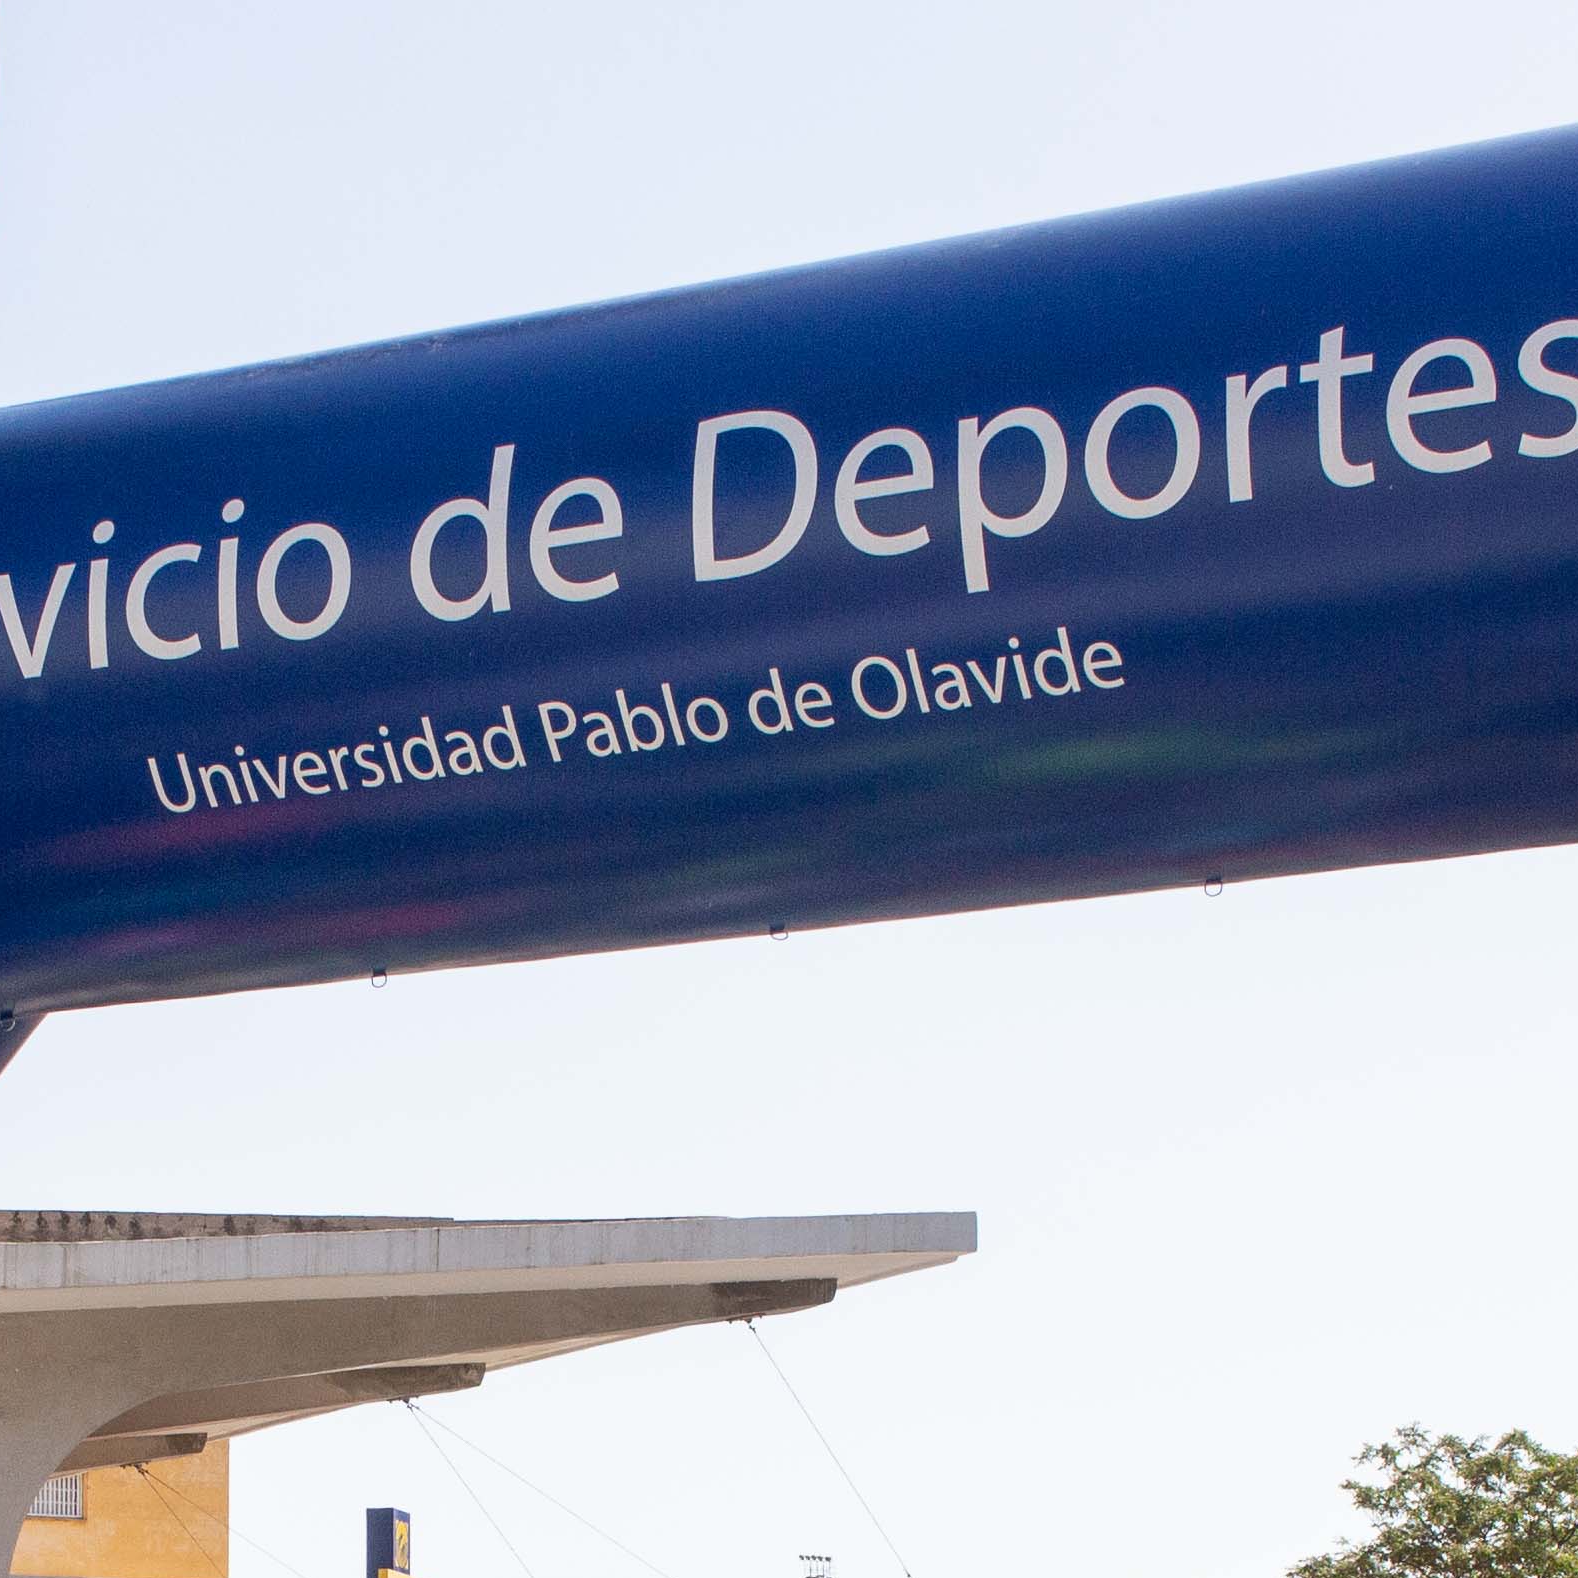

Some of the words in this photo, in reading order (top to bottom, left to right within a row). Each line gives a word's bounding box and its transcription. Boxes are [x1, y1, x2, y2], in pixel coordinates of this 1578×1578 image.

[408, 441, 623, 624] de
[145, 704, 528, 815] Universidad
[545, 681, 731, 763] Pablo
[745, 664, 836, 735] de
[851, 626, 1126, 722] Olavide
